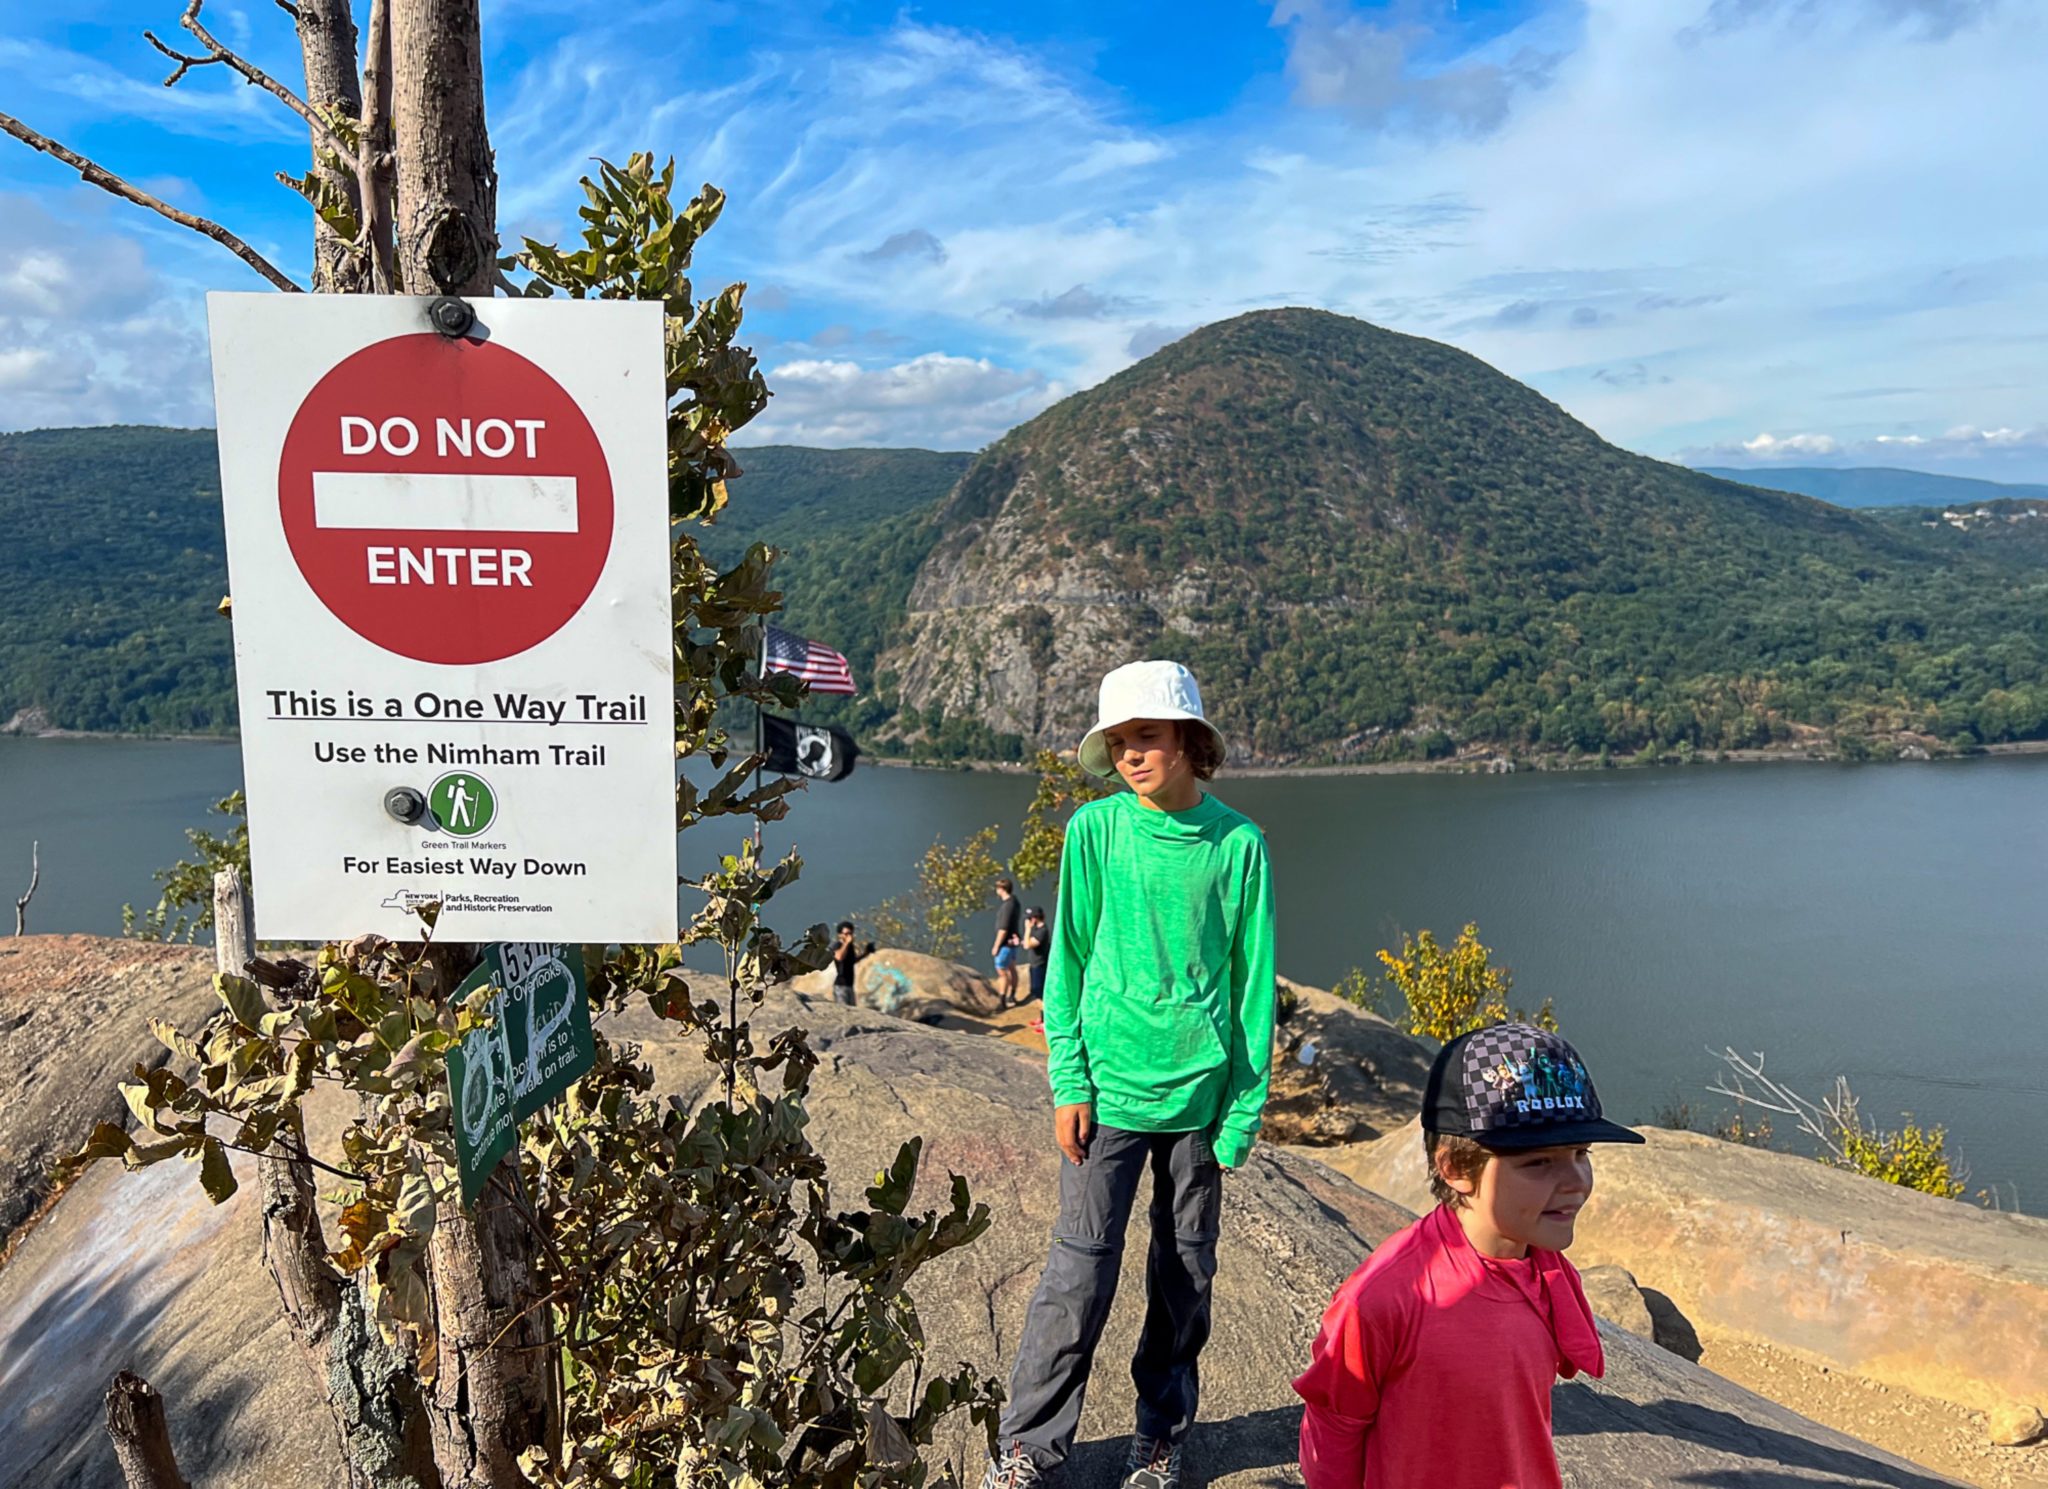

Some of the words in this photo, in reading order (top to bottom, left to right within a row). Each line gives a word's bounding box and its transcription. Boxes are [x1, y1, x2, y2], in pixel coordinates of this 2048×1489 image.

[340, 416, 420, 457] DO
[435, 418, 546, 459] NOT
[366, 546, 534, 587] ENTER
[266, 690, 337, 716] This
[347, 690, 374, 717] is
[384, 698, 403, 718] a
[414, 692, 484, 719] One
[493, 693, 567, 726] Way
[575, 694, 646, 721] Trail
[314, 742, 366, 763] Use
[374, 743, 418, 764] the
[427, 743, 540, 765] Nimham
[548, 744, 606, 766] Trail
[421, 841, 449, 849] Green
[451, 841, 469, 849] Trail
[471, 841, 507, 850] Markers
[343, 856, 380, 874] For
[386, 856, 464, 875] Easiest
[470, 857, 517, 879] Way
[523, 858, 587, 876] Down
[445, 893, 473, 904] Parks,
[473, 894, 520, 903] Recreation
[445, 904, 463, 912] and
[463, 904, 496, 912] Historic
[498, 904, 553, 913] Preservation
[547, 1039, 557, 1055] is
[558, 1032, 569, 1047] to
[544, 1062, 557, 1080] on
[558, 1044, 579, 1069] trail.
[1517, 1096, 1585, 1113] ROBLOX
[471, 1127, 496, 1172] continue
